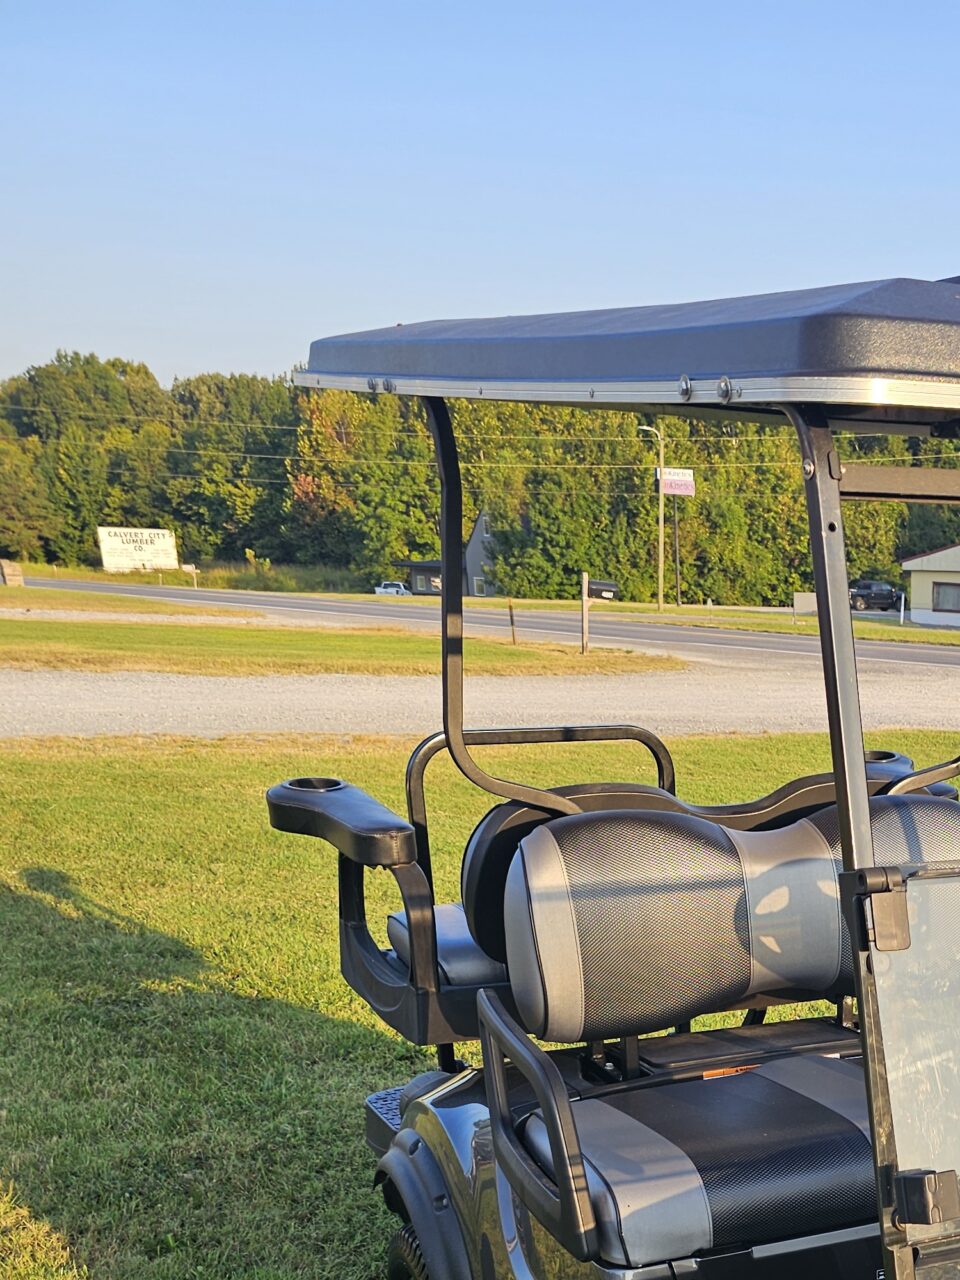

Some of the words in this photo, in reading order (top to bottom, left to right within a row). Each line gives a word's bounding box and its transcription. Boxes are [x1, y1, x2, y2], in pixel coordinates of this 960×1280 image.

[107, 530, 145, 539] CALVERT
[148, 532, 167, 540] CITY
[121, 538, 156, 546] LUMBER
